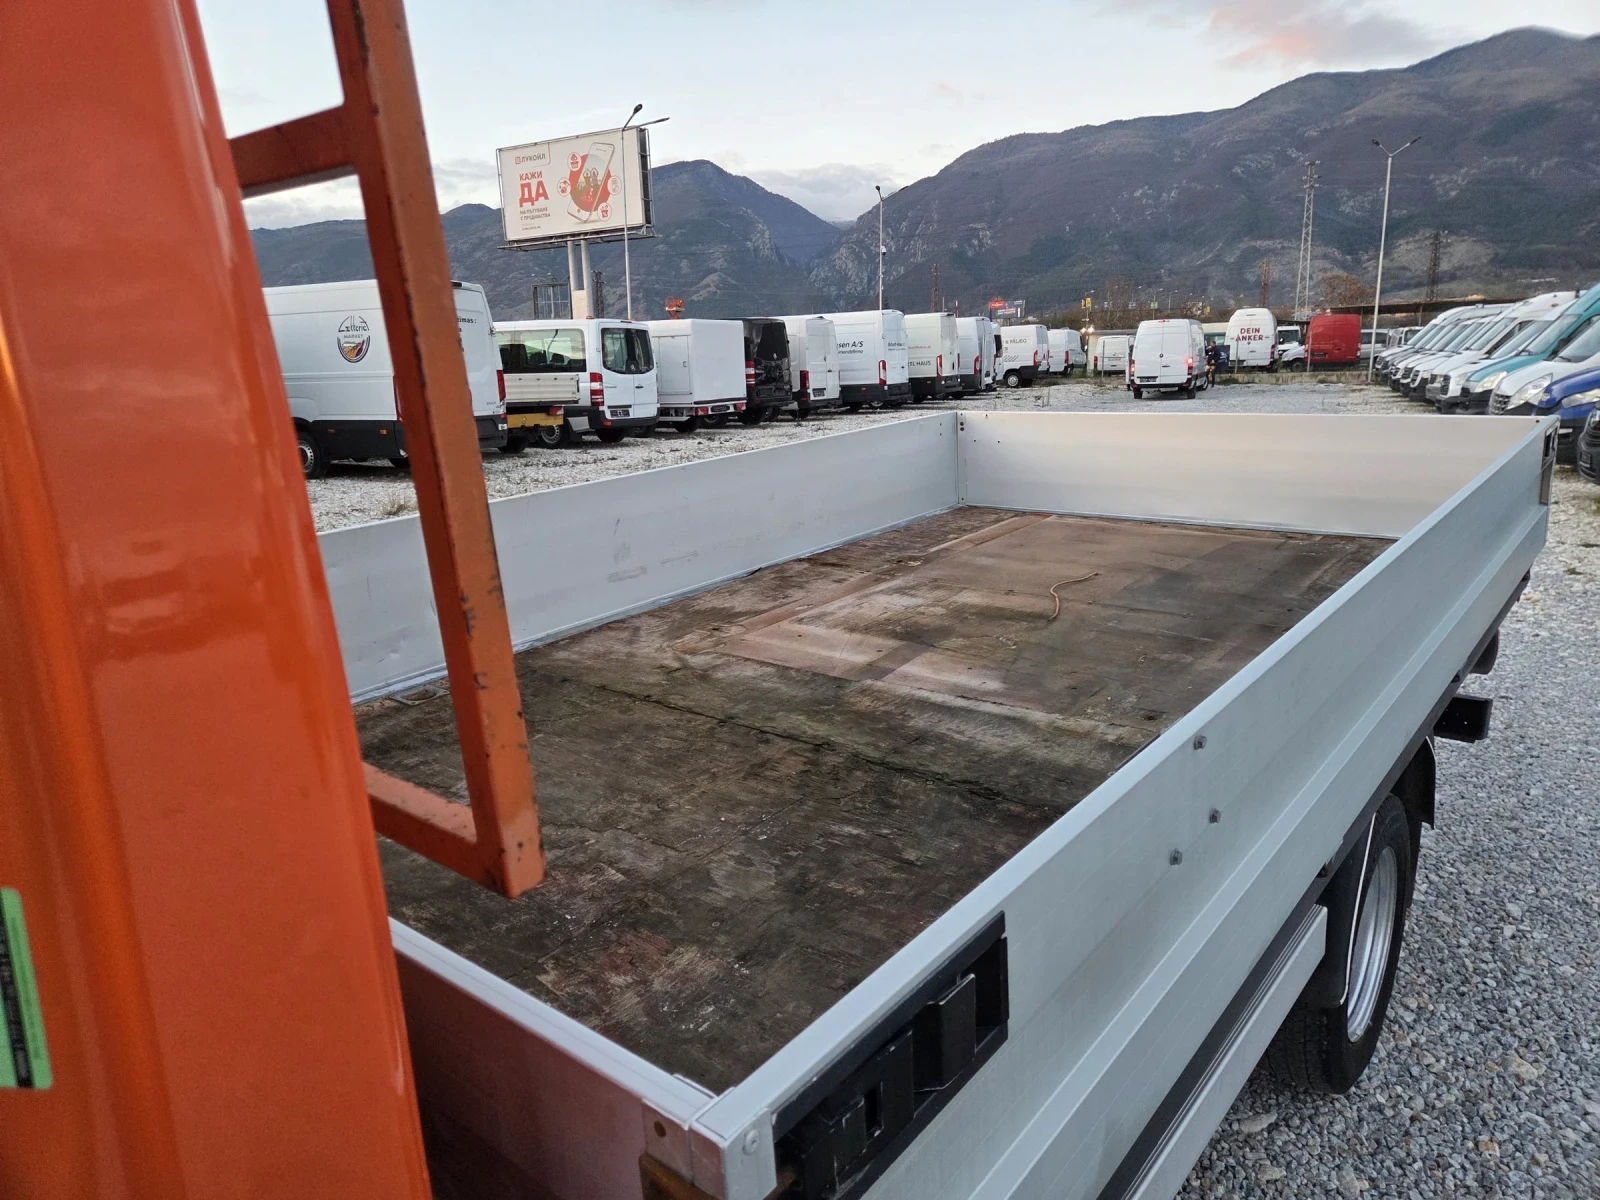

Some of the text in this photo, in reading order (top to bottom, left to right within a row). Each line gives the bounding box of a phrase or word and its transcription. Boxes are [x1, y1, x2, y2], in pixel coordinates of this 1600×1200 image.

[521, 153, 546, 163] ЛУКОЙЛ
[519, 170, 543, 181] КАЖИ
[519, 180, 550, 208] ДА
[1240, 327, 1260, 335] DEIN
[1235, 334, 1264, 342] ANKER
[850, 340, 864, 348] A/S
